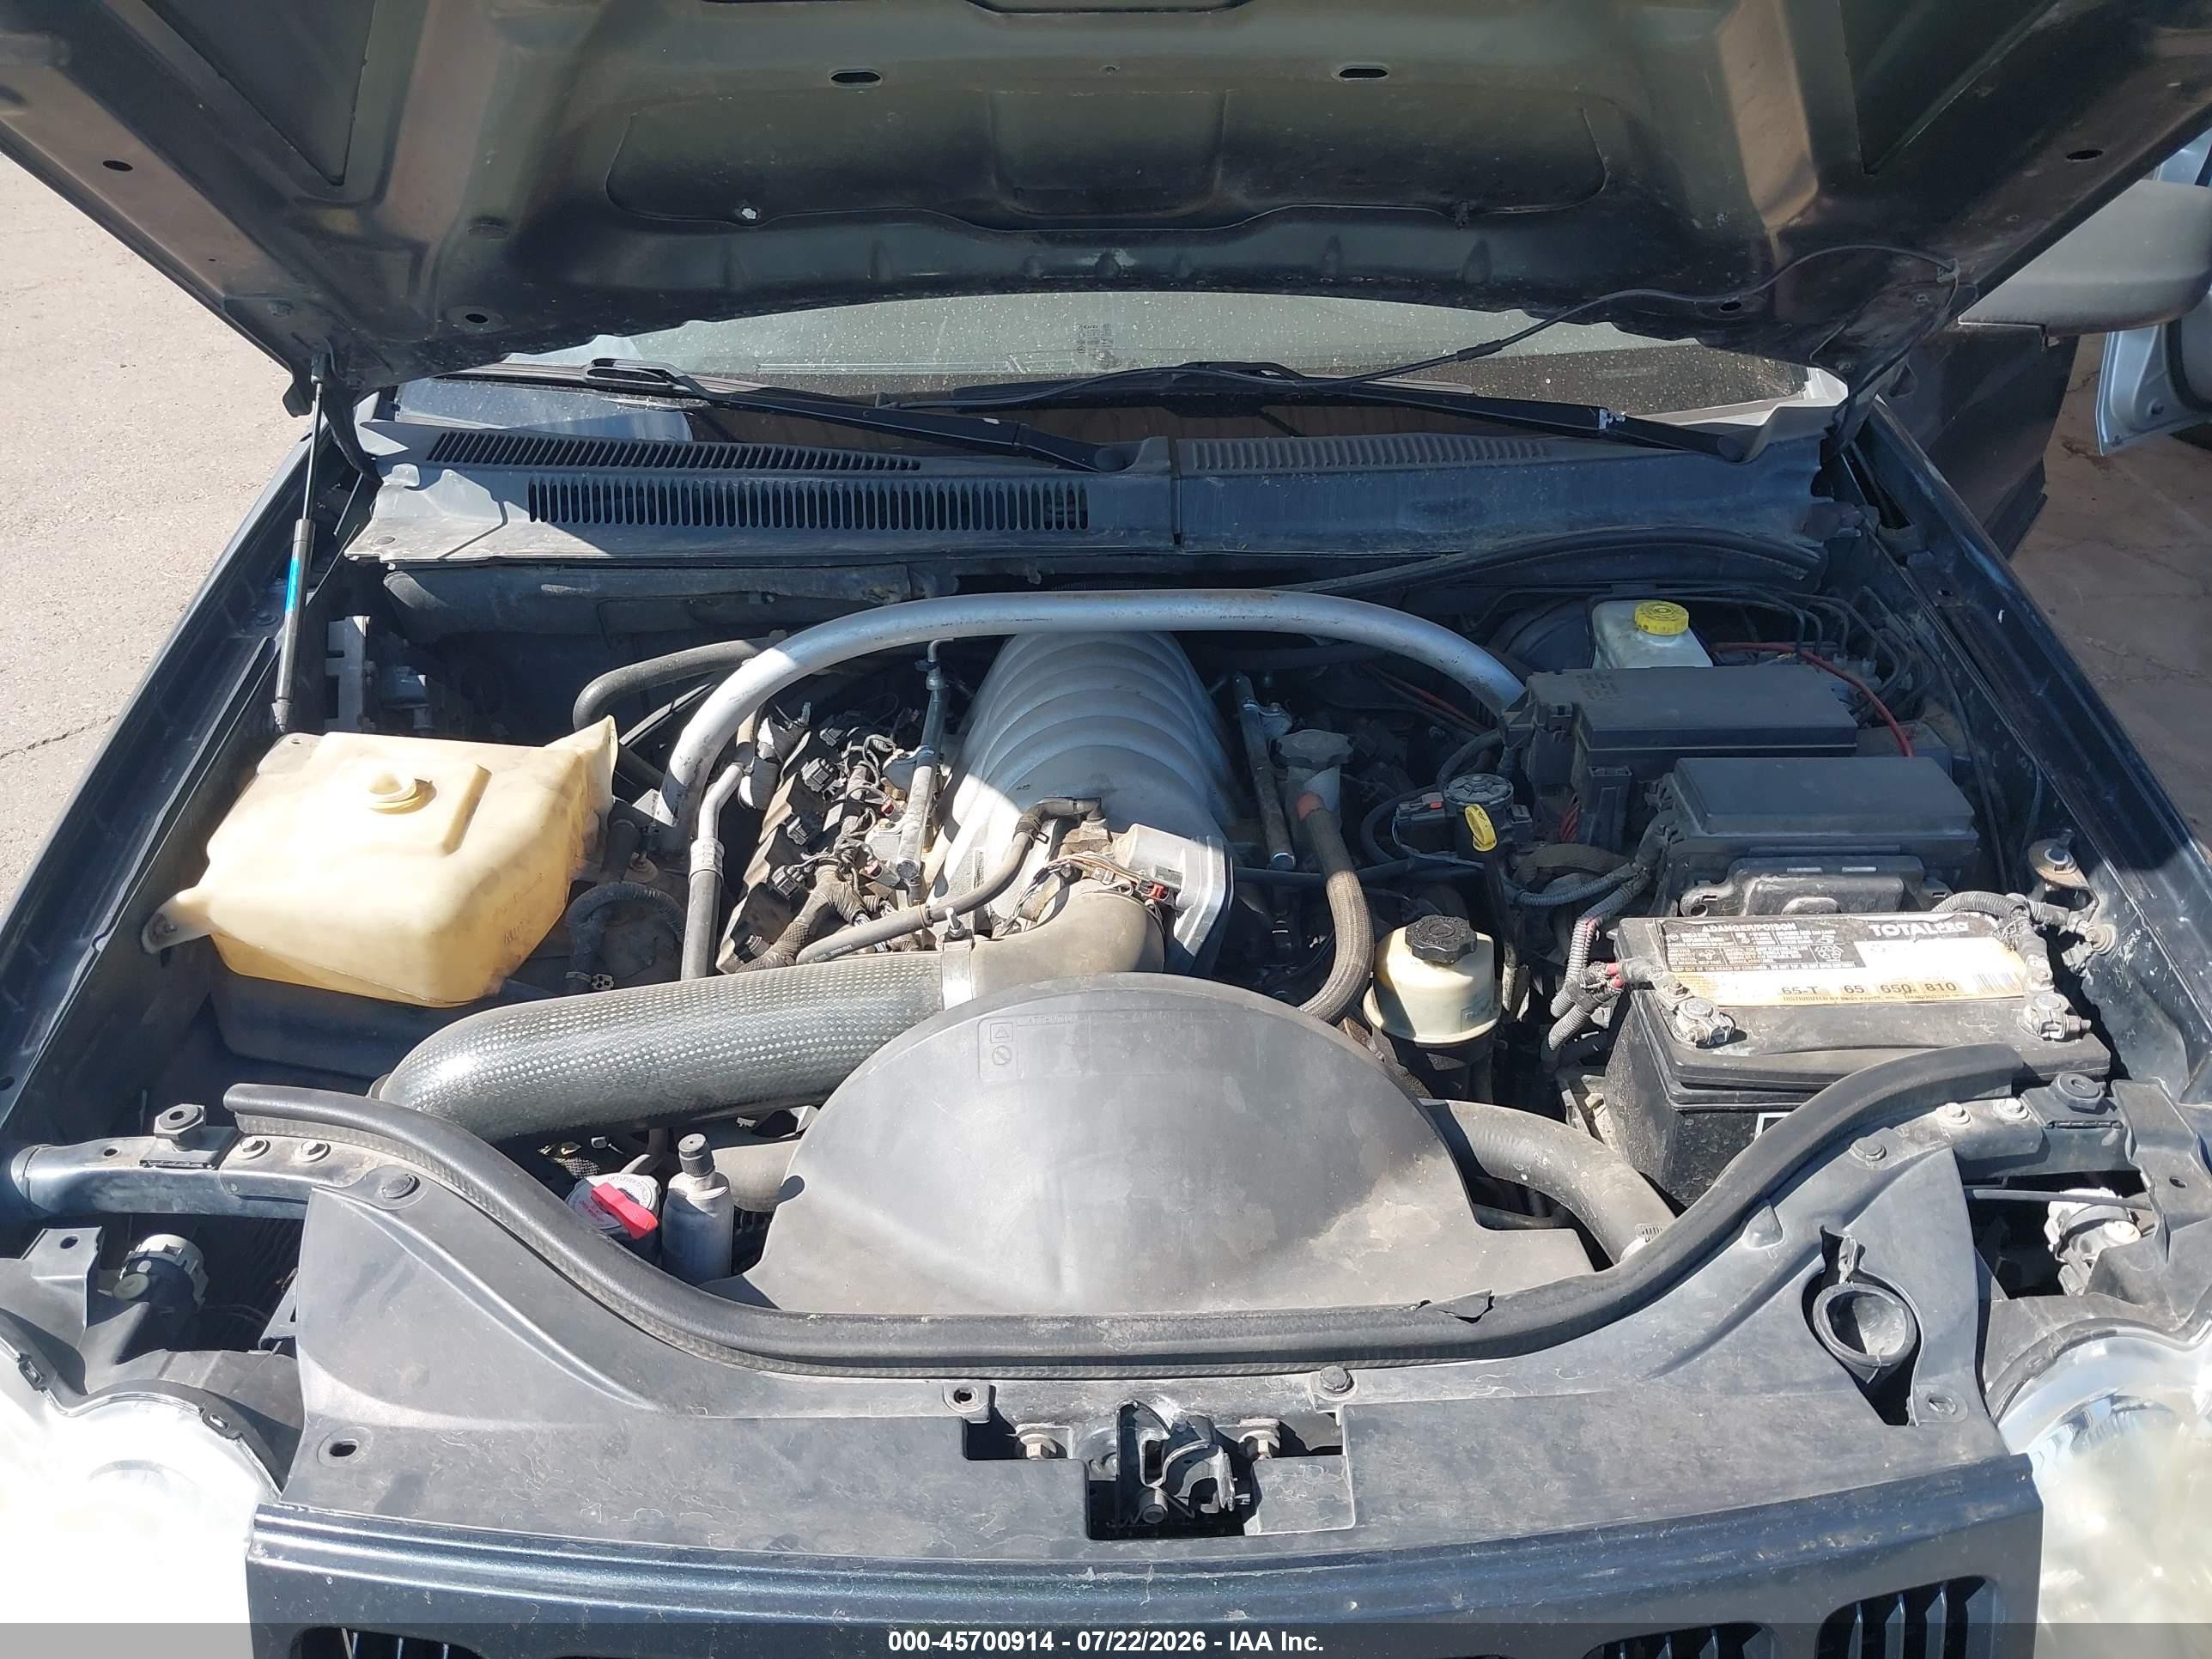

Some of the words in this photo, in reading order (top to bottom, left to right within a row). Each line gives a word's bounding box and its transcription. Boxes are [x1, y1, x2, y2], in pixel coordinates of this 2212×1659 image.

[1781, 985, 1818, 995] 65-T
[1844, 984, 1865, 994] 65
[1924, 981, 1958, 993] 810
